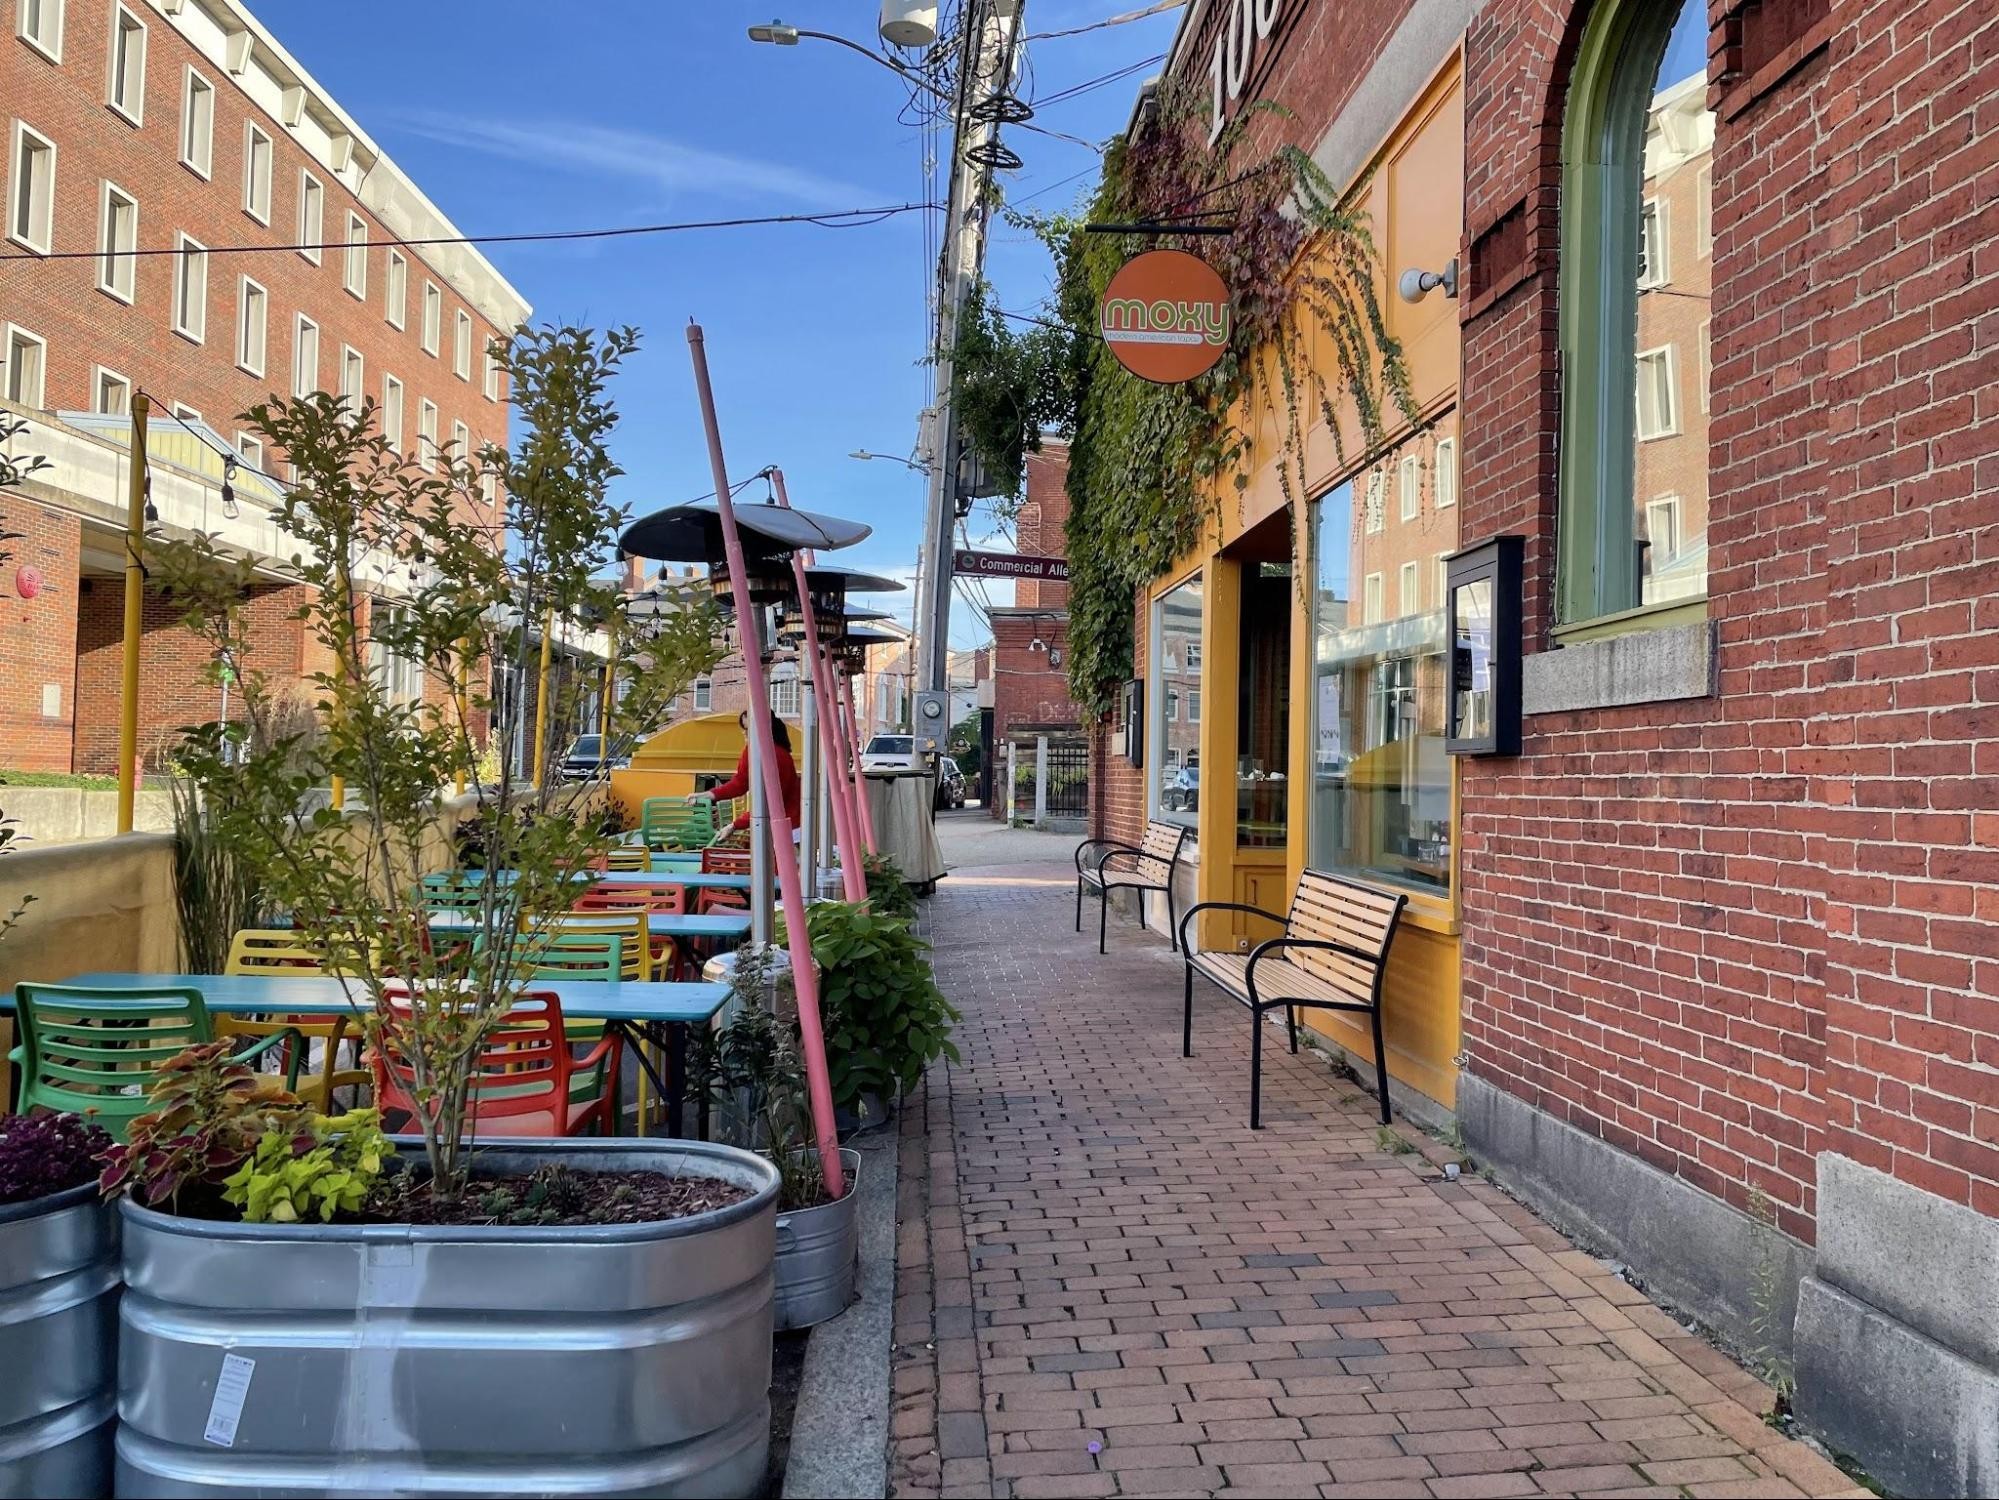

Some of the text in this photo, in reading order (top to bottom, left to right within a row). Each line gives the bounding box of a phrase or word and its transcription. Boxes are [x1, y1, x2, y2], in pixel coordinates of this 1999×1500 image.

[1105, 298, 1229, 346] moxy
[979, 557, 1069, 577] Commercial Alle
